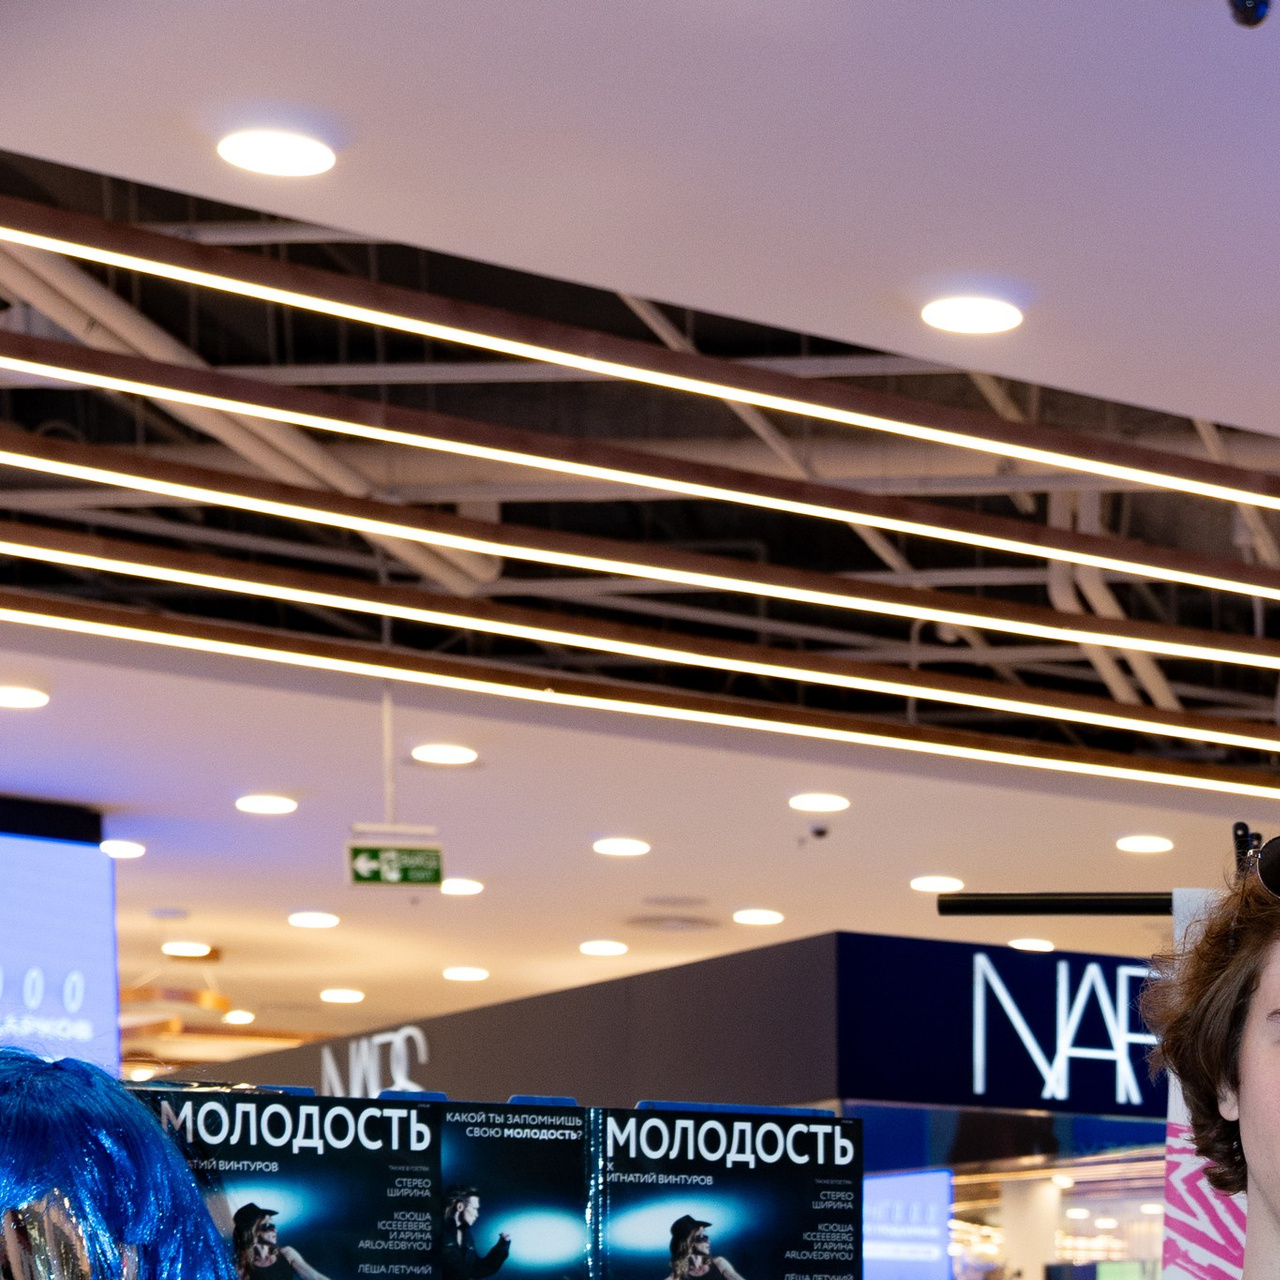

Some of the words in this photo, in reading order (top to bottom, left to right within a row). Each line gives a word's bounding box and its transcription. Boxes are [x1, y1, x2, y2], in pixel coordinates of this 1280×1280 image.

[446, 1111, 486, 1124] КАКОЙ
[488, 1114, 504, 1124] ТЫ
[506, 1114, 583, 1127] ЗАПОМНИШЬ
[161, 1101, 431, 1154] МОЛОДОСТЬ
[466, 1126, 501, 1138] СВОЮ
[503, 1128, 583, 1140] МОЛОДОСТЬ?
[606, 1117, 855, 1168] МОЛОДОСТЬ
[218, 1160, 279, 1172] ВИНТУРОВ
[394, 1178, 431, 1188] СТЕРЕО
[606, 1172, 656, 1184] ИГНАТИЙ
[658, 1174, 713, 1186] ВИНТУРОВ
[387, 1188, 431, 1197] ШИРИНА
[820, 1191, 854, 1200] СТЕРЕО
[812, 1201, 853, 1209] ШИРИНА
[394, 1211, 431, 1221] КСЮША
[818, 1223, 853, 1232] КСЮША
[398, 1231, 432, 1240] АРИНА
[822, 1242, 853, 1250] АРИНА
[387, 1264, 432, 1274] ЛЕТУЧИЙ
